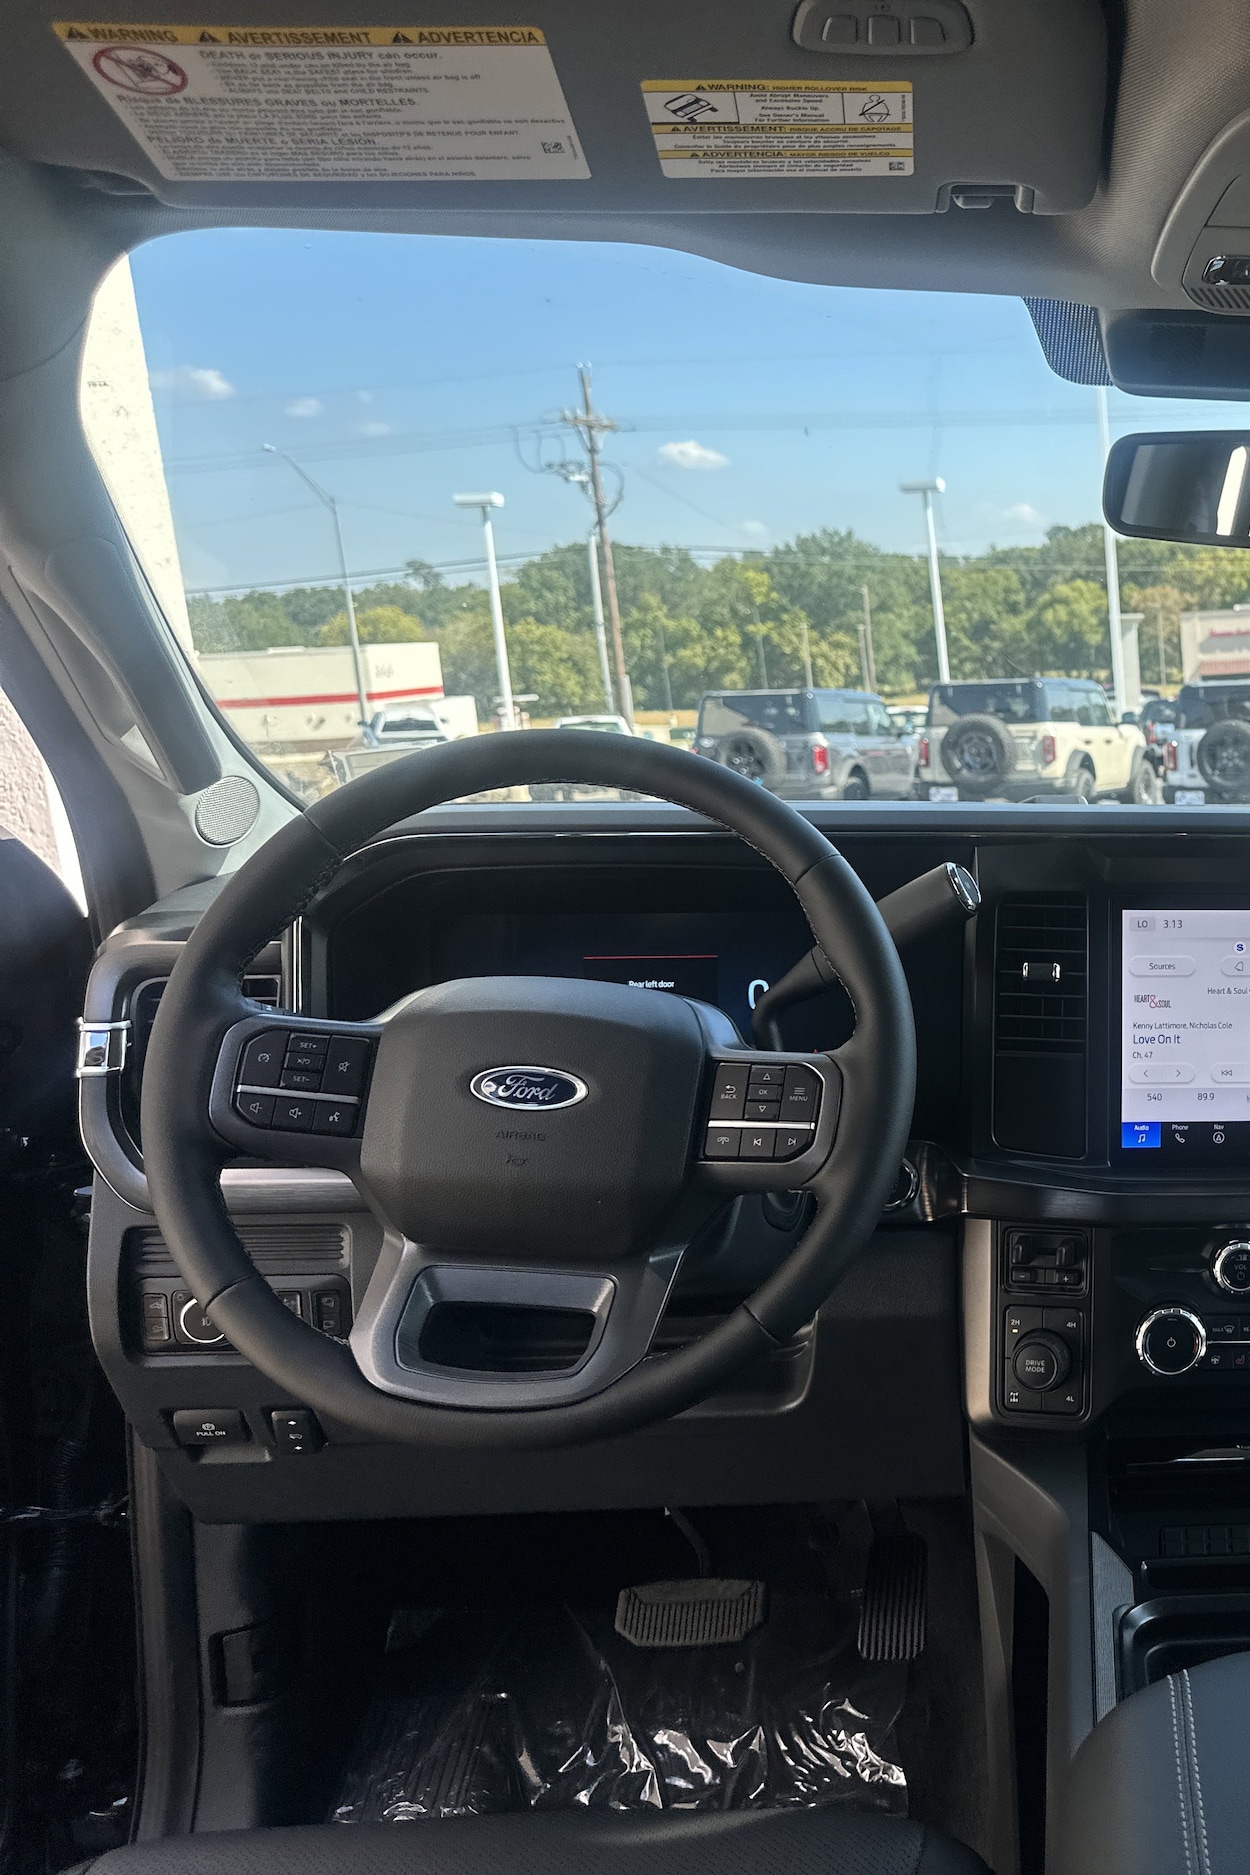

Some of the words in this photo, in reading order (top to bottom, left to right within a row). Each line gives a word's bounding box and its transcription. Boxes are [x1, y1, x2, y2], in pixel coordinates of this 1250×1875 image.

[88, 28, 178, 43] WARNING
[227, 31, 371, 44] AVERTISSEMENT
[418, 31, 539, 44] ADVERTENCIA
[200, 52, 244, 60] DEATH
[264, 52, 325, 60] SERIOUS
[328, 52, 374, 60] INJURY
[1137, 920, 1148, 928] LO
[1163, 919, 1183, 929] 3:13
[1149, 962, 1176, 970] Sources
[629, 980, 645, 988] Rear
[645, 980, 658, 988] left
[658, 980, 675, 988] door
[1207, 987, 1225, 995] Heart
[1227, 987, 1232, 995] &
[1233, 987, 1248, 995] Soul
[1134, 995, 1150, 1003] HEART
[1157, 1000, 1171, 1008] SOUL
[1133, 1022, 1153, 1030] Kenny
[1154, 1022, 1188, 1030] Lattimore,
[1133, 1034, 1156, 1045] Love
[1157, 1034, 1172, 1045] On
[1173, 1034, 1181, 1045] It
[497, 1074, 556, 1101] Ford
[720, 1092, 737, 1100] BACK
[758, 1088, 768, 1096] OK
[1147, 1093, 1162, 1101] 540
[1197, 1092, 1215, 1101] 89.9
[495, 1130, 546, 1142] AIRBAG
[1234, 1263, 1247, 1271] VOL
[1010, 1318, 1020, 1326] 2H
[1025, 1359, 1045, 1367] DRIVE
